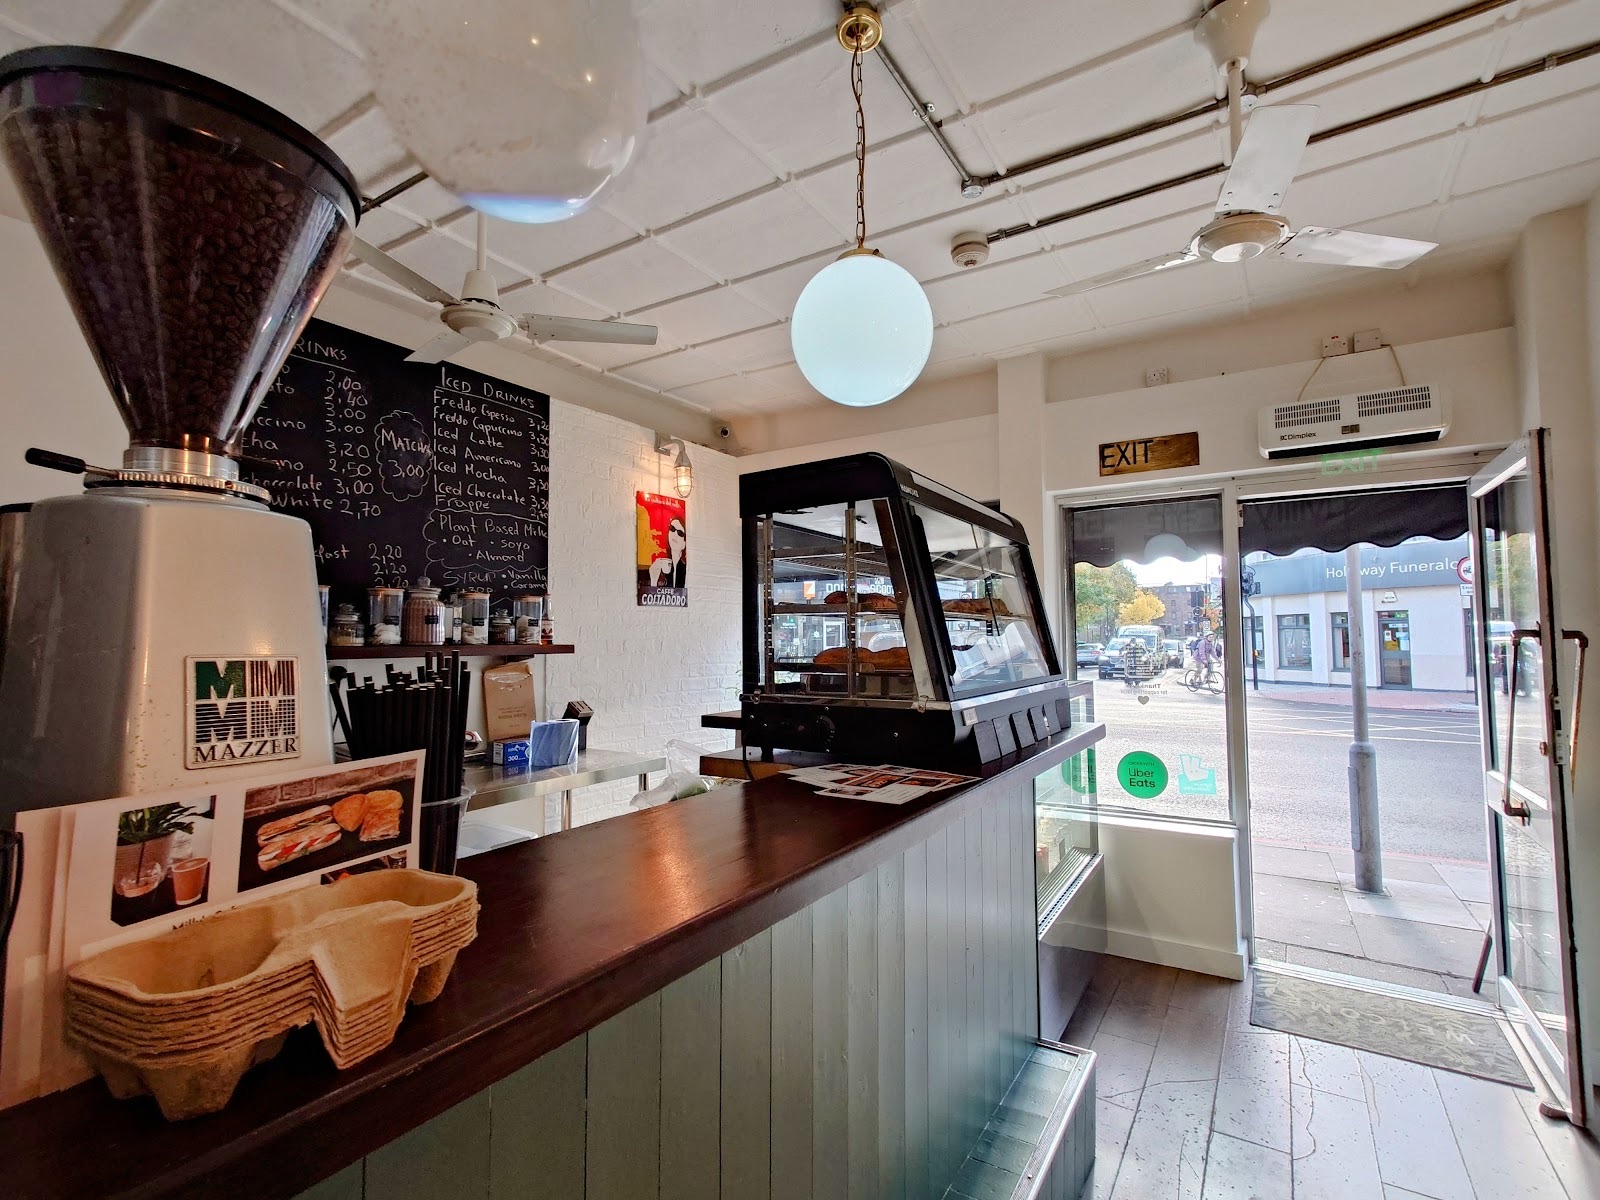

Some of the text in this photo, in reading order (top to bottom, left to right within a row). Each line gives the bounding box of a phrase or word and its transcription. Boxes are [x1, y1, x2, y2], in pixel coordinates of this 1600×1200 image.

[293, 337, 347, 360] RINKS
[433, 389, 477, 414] Freddo
[483, 382, 535, 409] DRINKS
[433, 405, 469, 427] Freddo
[433, 420, 459, 441] Iced
[470, 431, 505, 449] Latte
[1287, 431, 1317, 440] Dimplex
[325, 439, 370, 459] 3,20
[433, 438, 457, 457] Iced
[464, 446, 522, 469] Americano
[1101, 439, 1154, 469] EXIT
[328, 458, 372, 478] 2,50
[388, 459, 425, 478] 3,00
[433, 455, 457, 474] Iced
[465, 463, 508, 484] Mocha
[333, 478, 374, 495] 3,00
[433, 474, 462, 496] Iced
[340, 498, 382, 520] 2,70
[439, 513, 478, 534] Plant
[484, 518, 519, 536] Based
[451, 534, 477, 548] Oat
[368, 542, 402, 565] 2,20
[476, 550, 525, 563] Almond
[371, 562, 407, 575] 2,20
[507, 569, 548, 581] Vanilla
[1325, 558, 1460, 580] Holway Funeralc
[510, 579, 549, 590] Caramel
[641, 593, 686, 607] COSTADORO
[193, 738, 298, 764] MAZZER
[1128, 768, 1154, 778] Uber
[1129, 778, 1156, 788] Eats
